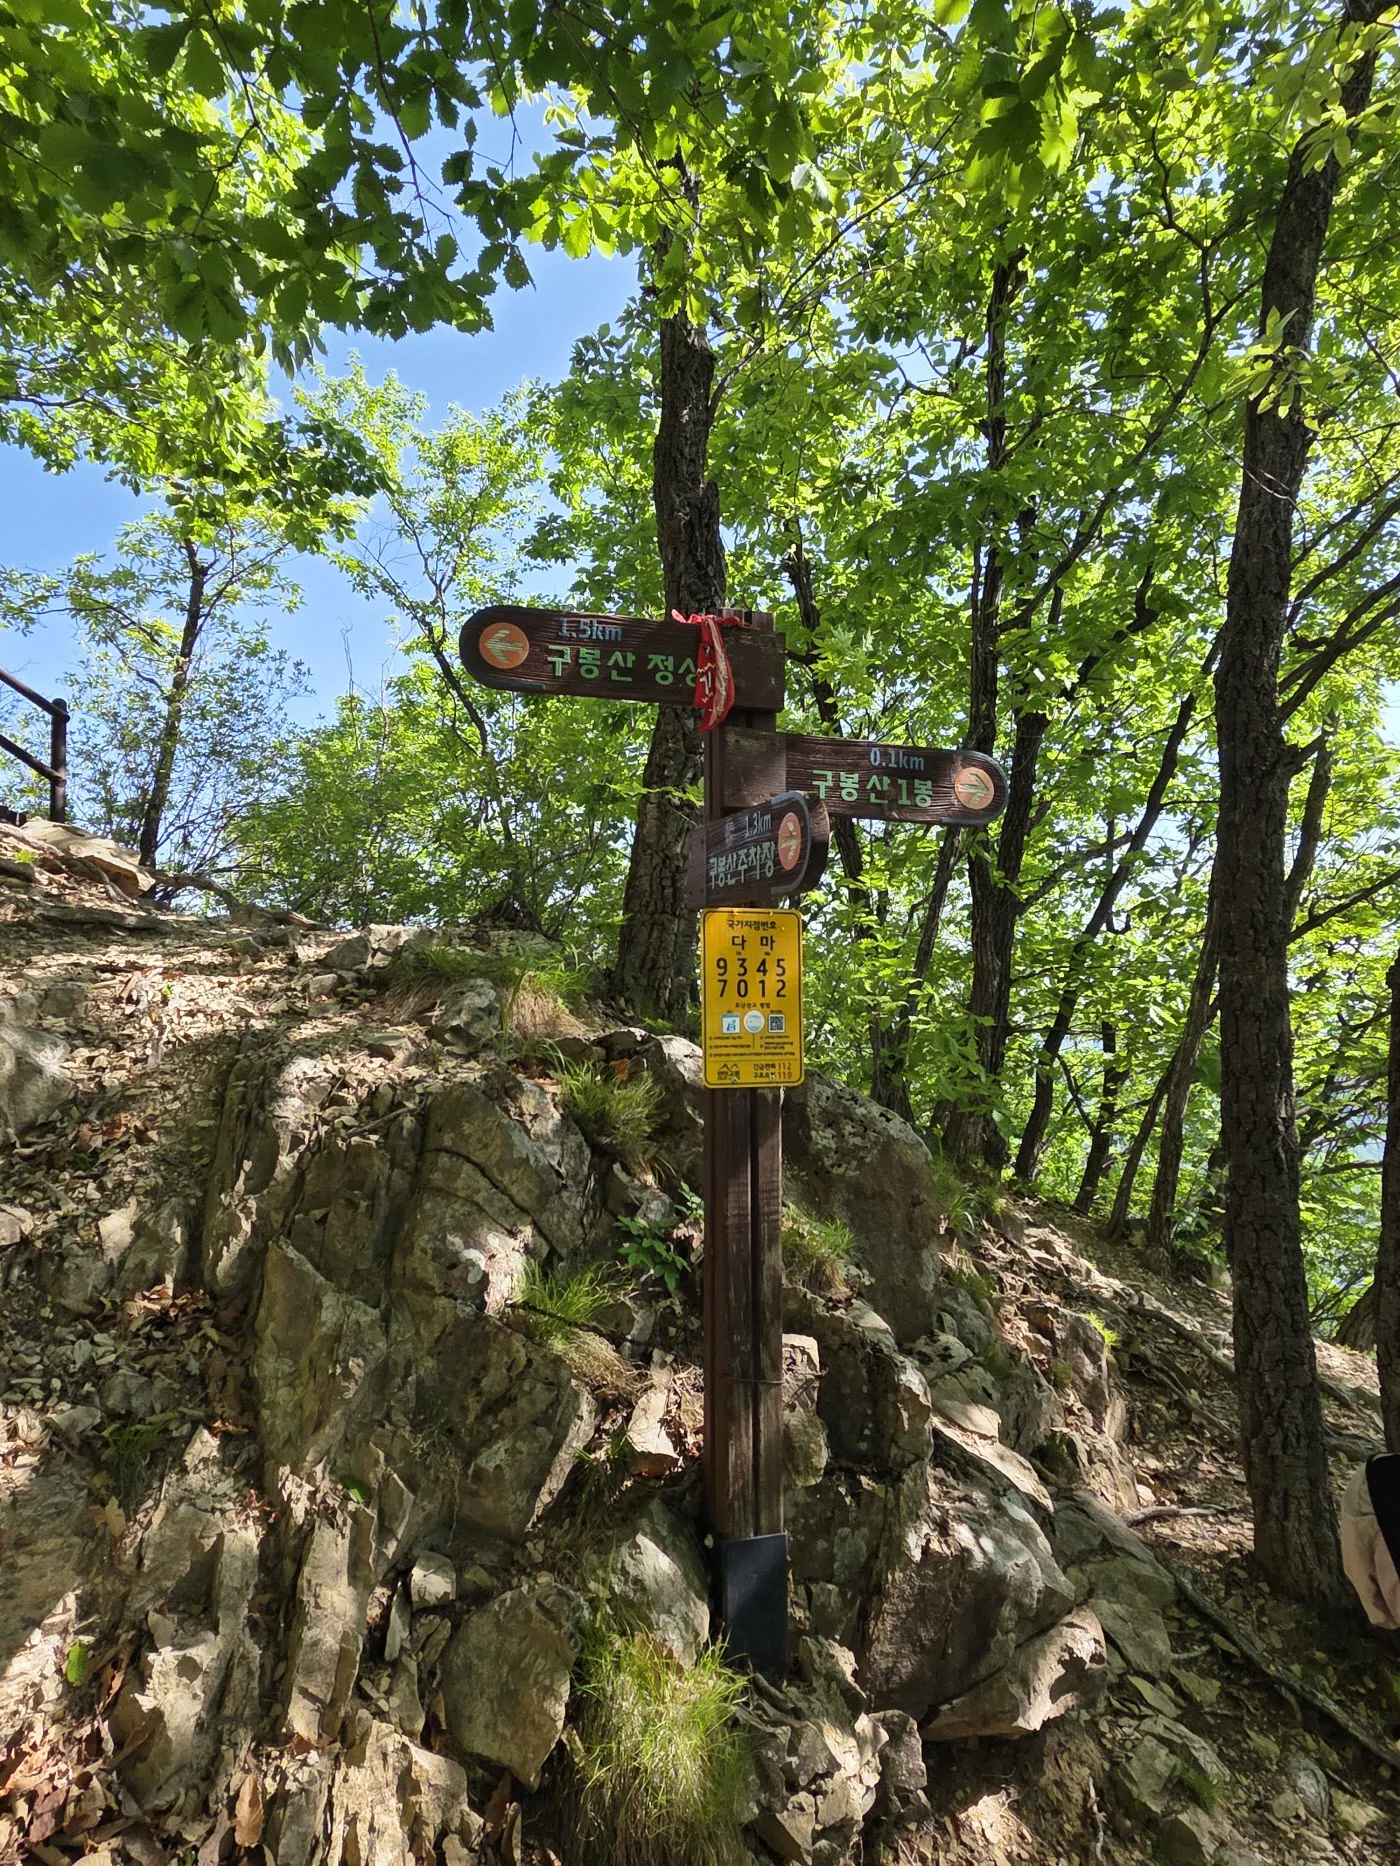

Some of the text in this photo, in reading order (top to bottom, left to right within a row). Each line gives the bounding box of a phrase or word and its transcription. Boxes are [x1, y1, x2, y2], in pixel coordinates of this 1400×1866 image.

[558, 617, 623, 642] 1.5km
[547, 644, 636, 683] 구봉산
[869, 747, 925, 771] 0.1km
[743, 810, 772, 839] 1.3km
[727, 919, 777, 931] 국가지점번호
[731, 934, 776, 951] 다 마
[716, 957, 786, 977] 9345
[717, 979, 787, 998] 7012
[777, 1062, 792, 1071] 112
[777, 1071, 792, 1080] 119
